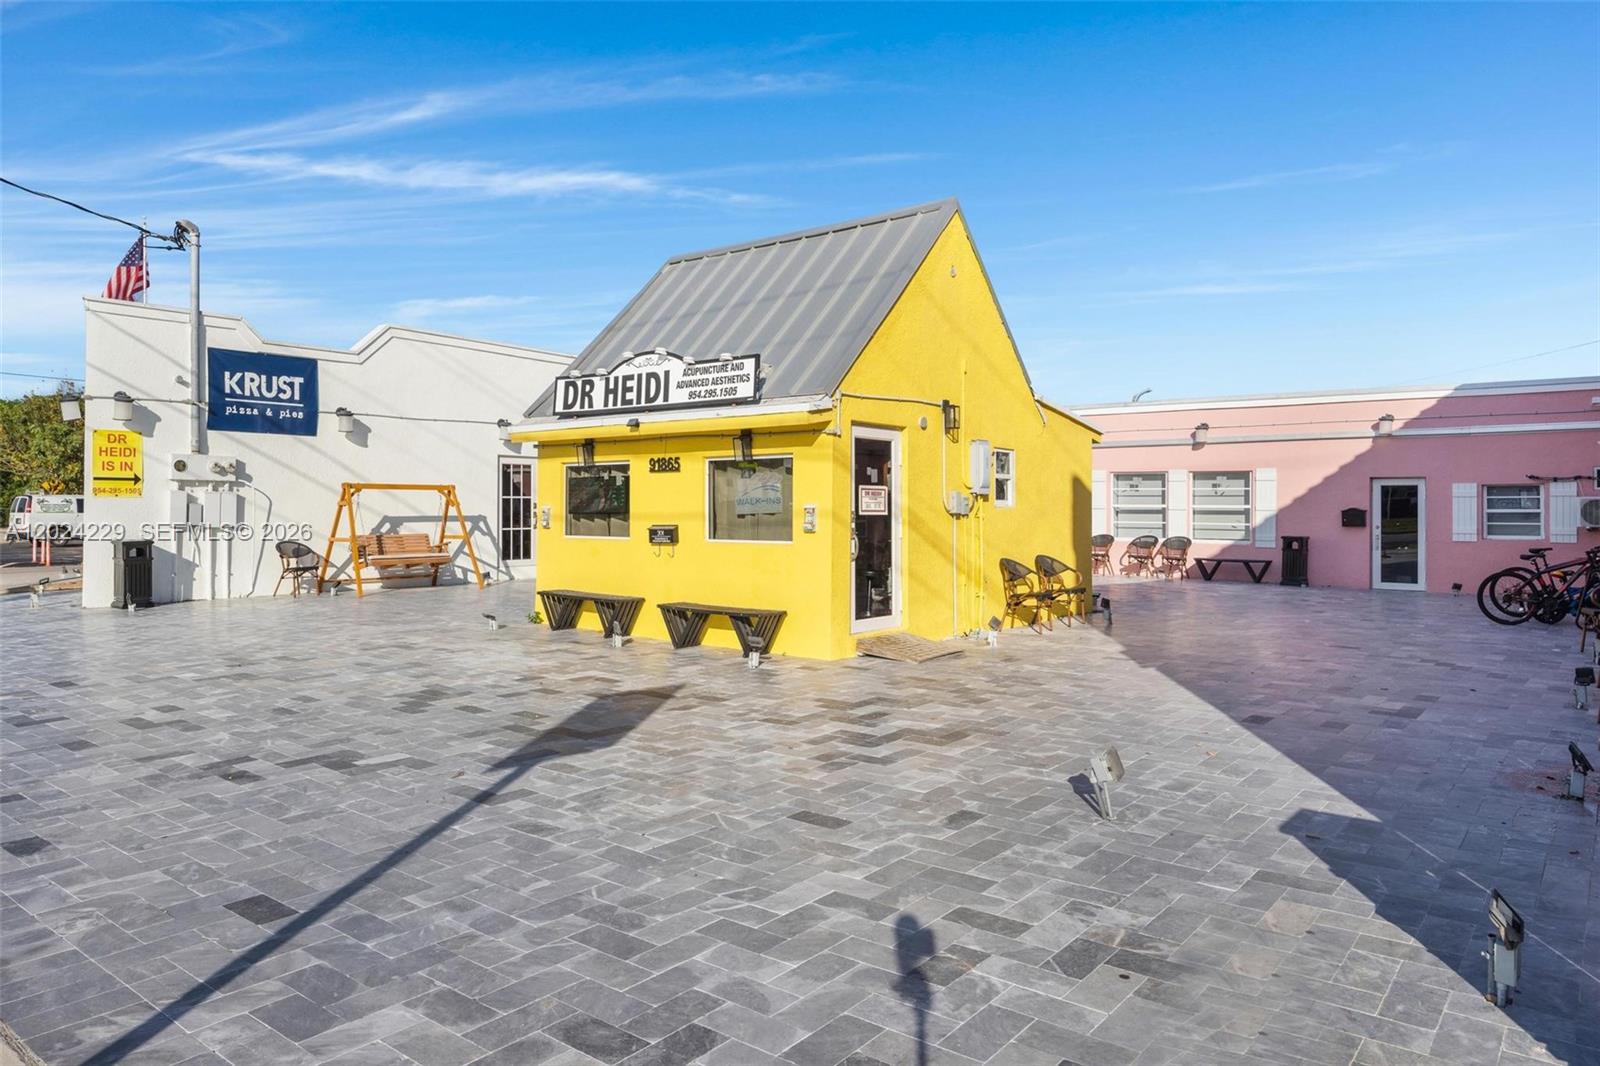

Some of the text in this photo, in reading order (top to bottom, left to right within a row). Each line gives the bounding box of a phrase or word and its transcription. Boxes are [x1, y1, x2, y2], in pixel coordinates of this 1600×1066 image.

[682, 362, 745, 377] ACUPUNCTURE AND
[224, 371, 304, 400] KRUST
[676, 373, 751, 389] ADVANCED AESTHETICS
[562, 370, 670, 410] DR HEIDI
[687, 386, 738, 400] 954.295.1505
[225, 405, 304, 419] pizza & pies
[107, 433, 127, 444] DR
[99, 447, 136, 458] HEIDI
[102, 461, 133, 472] IS IN
[649, 457, 681, 473] 91865
